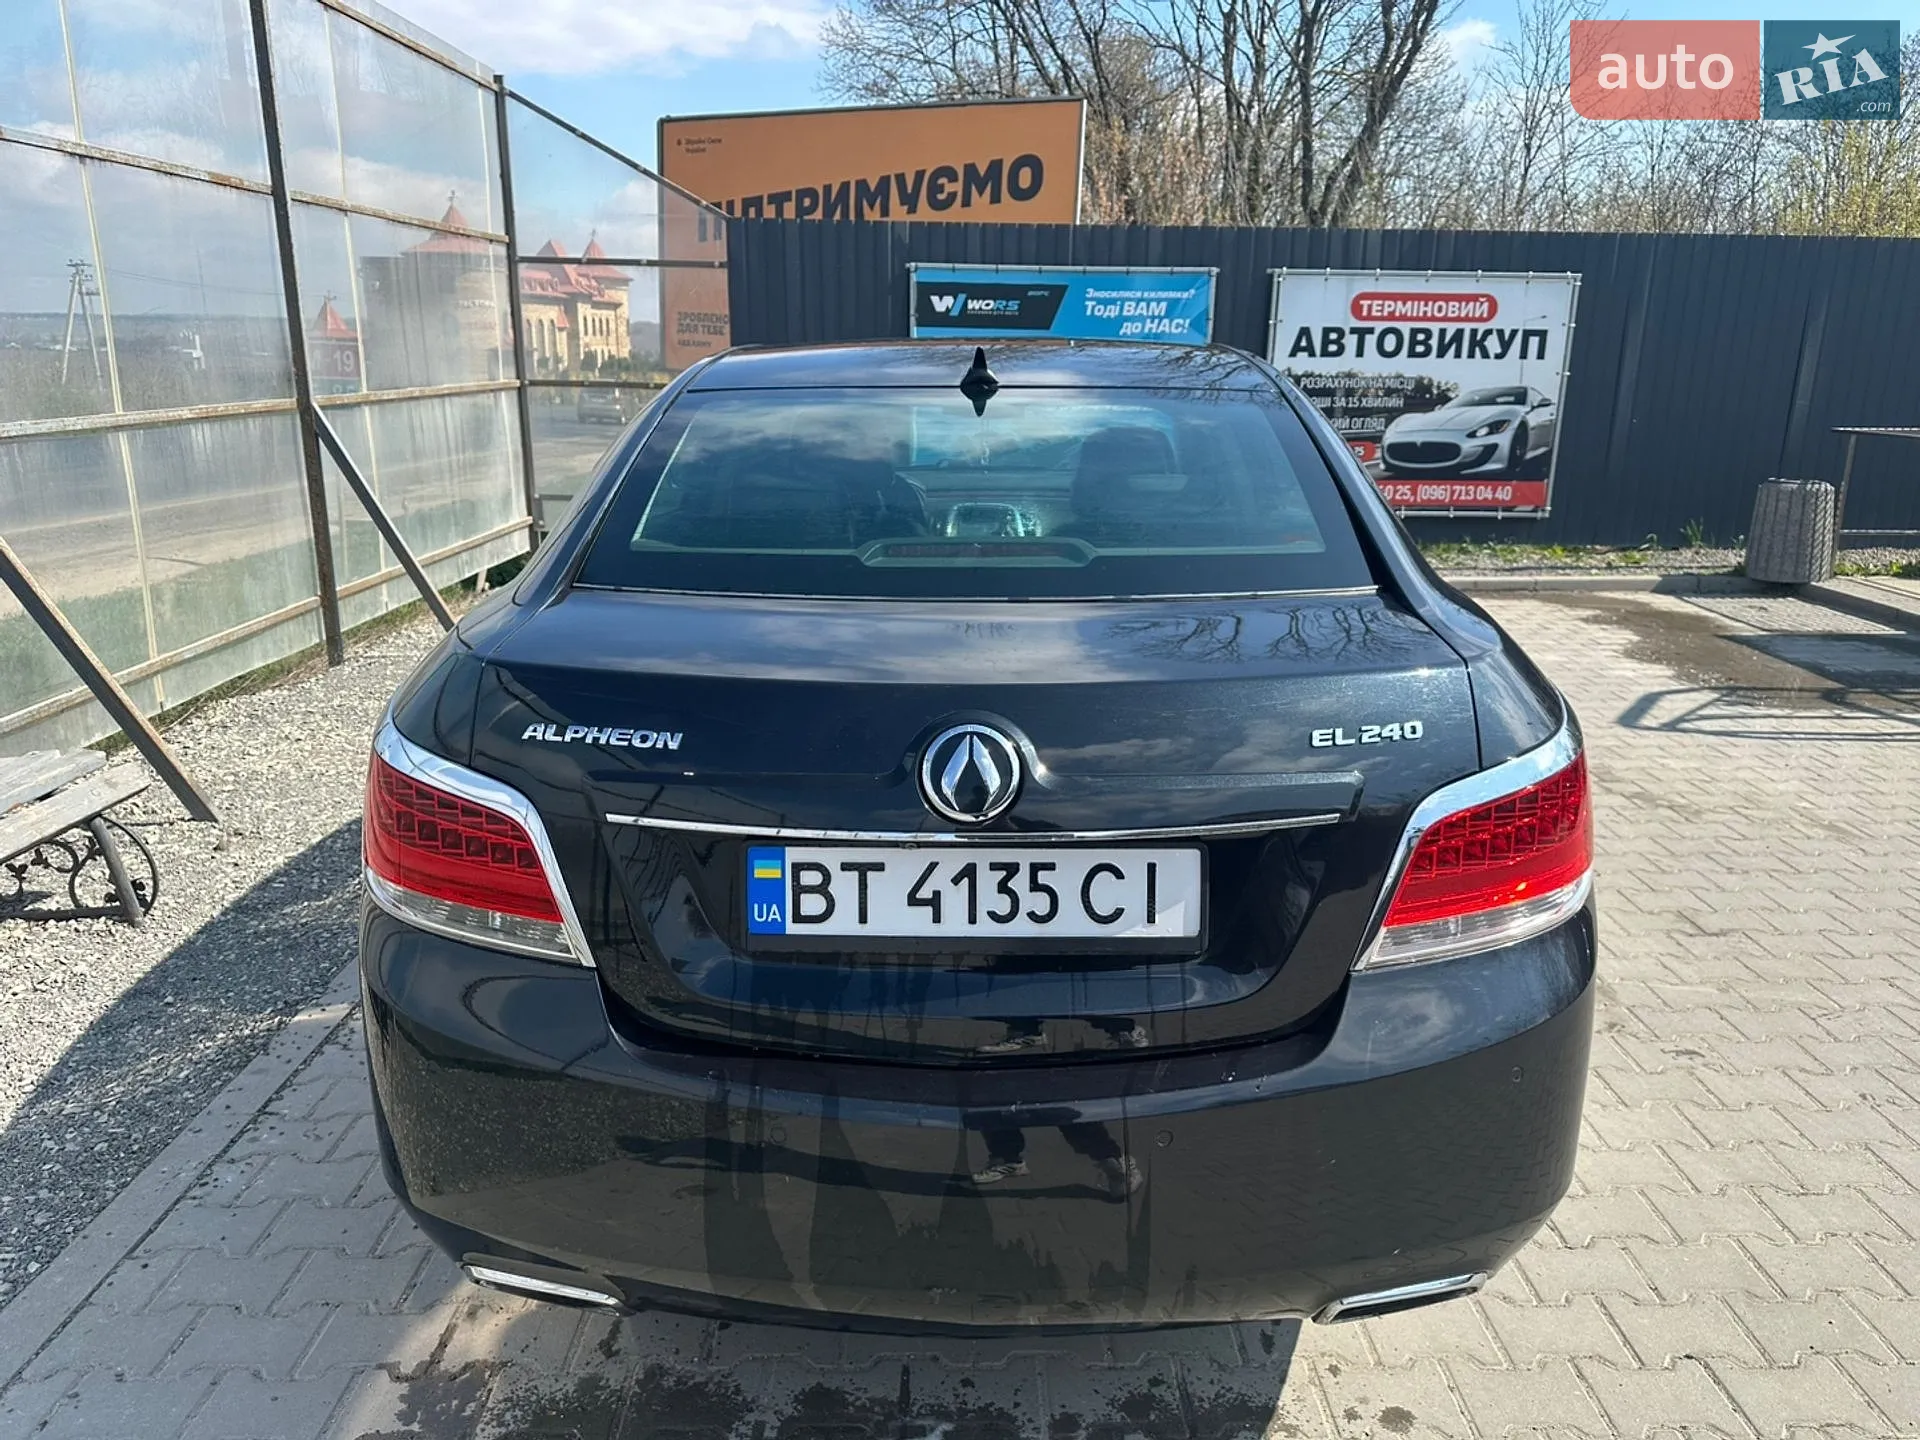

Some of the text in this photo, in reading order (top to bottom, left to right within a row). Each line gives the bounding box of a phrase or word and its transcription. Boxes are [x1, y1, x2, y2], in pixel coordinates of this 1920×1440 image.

[967, 299, 1020, 311] WORS
[1084, 301, 1168, 318] Тоді ВАМ
[1359, 297, 1489, 318] ТЕРМІНОВИЙ
[1119, 318, 1190, 336] до НАС!
[1288, 326, 1549, 360] АВТОВИКУП
[1300, 376, 1416, 390] РОЗРАХУНОК НА МІСЦІ
[1332, 396, 1346, 408] ЗА
[1347, 396, 1360, 408] 15
[1360, 397, 1405, 409] ХВИЛИН
[1350, 417, 1386, 431] ОГЛЯД
[1416, 484, 1450, 503] (096)
[1452, 485, 1474, 500] 713
[1476, 486, 1493, 500] 04
[1494, 486, 1512, 501] 40
[521, 722, 683, 750] ALPHEON
[1310, 720, 1423, 747] EL 240
[790, 861, 1157, 924] BT 4135 CI
[753, 903, 782, 923] UA
